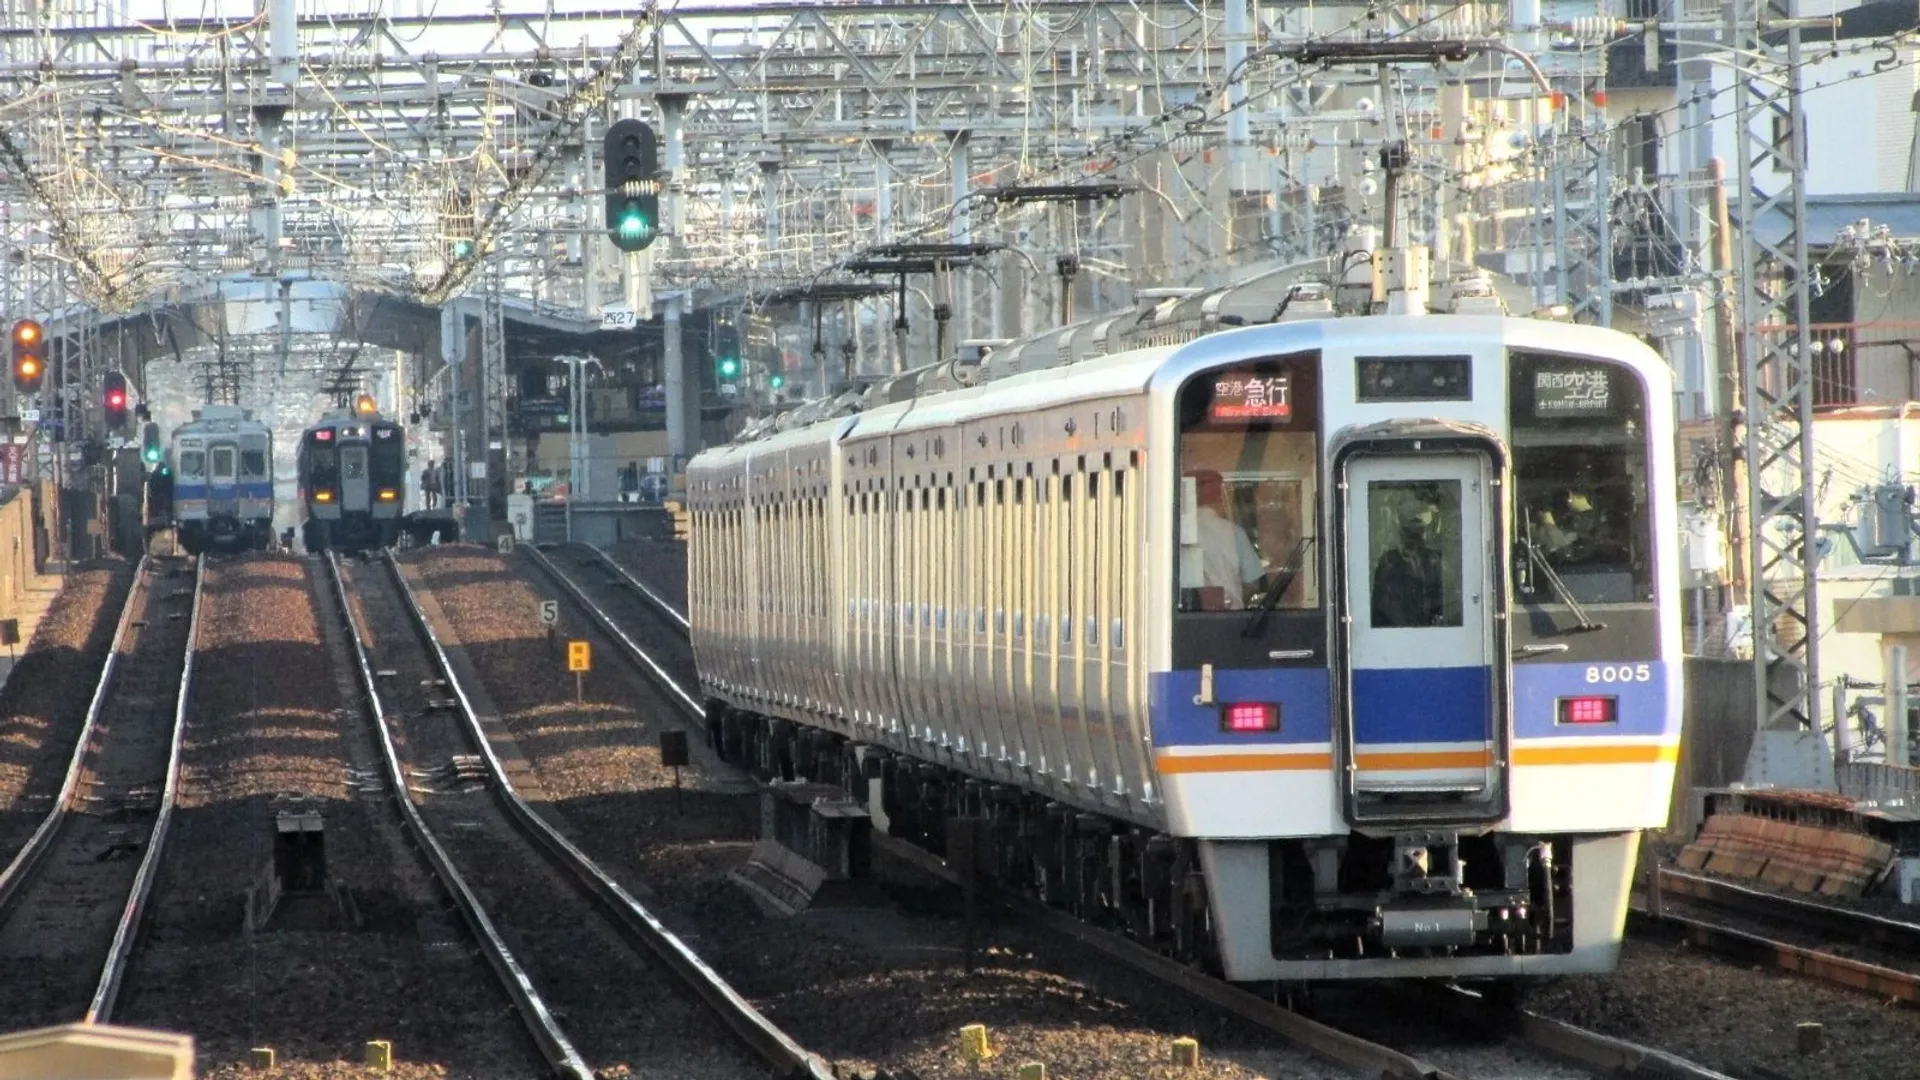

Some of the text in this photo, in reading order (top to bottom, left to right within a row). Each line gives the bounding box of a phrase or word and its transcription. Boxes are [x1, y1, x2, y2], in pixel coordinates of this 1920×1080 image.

[1537, 370, 1609, 400] 関西空港
[499, 537, 511, 551] 4
[543, 602, 556, 622] 5
[1586, 664, 1650, 683] 8005
